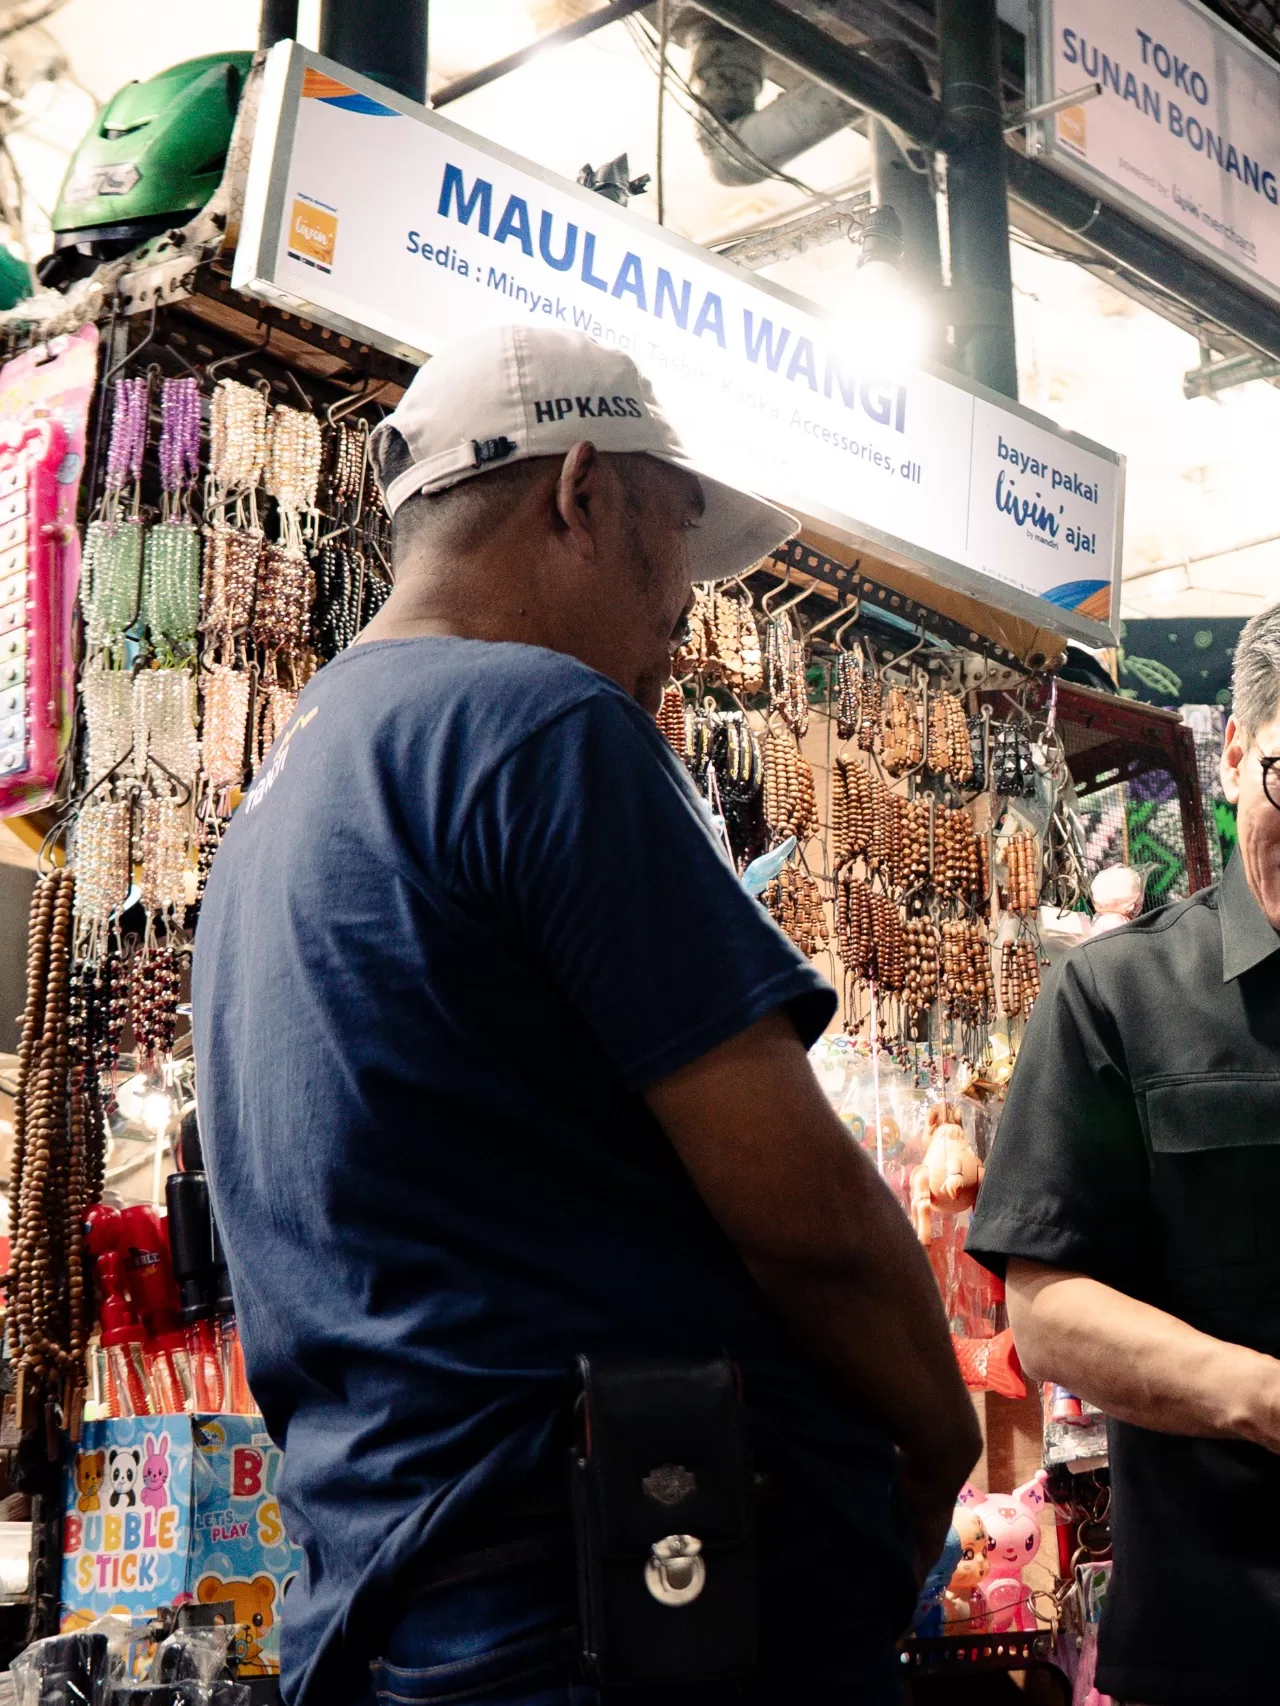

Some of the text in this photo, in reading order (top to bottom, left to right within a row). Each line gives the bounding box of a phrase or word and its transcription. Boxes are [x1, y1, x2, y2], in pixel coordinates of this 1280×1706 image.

[1136, 28, 1209, 106] TOKO
[1063, 27, 1280, 206] SUNAN BONANG
[437, 162, 908, 434] MAULANA WANGI
[406, 230, 471, 277] Sedia
[486, 271, 567, 321] Minyak
[790, 409, 896, 476] Accessories,
[899, 458, 921, 485] dll
[997, 435, 1099, 504] bayar pakai
[995, 469, 1096, 554] livin' aja!
[1034, 534, 1059, 550] mandiri
[63, 1510, 176, 1554] BUBBLE
[212, 1522, 249, 1542] PLAY
[79, 1554, 155, 1588] STICK
